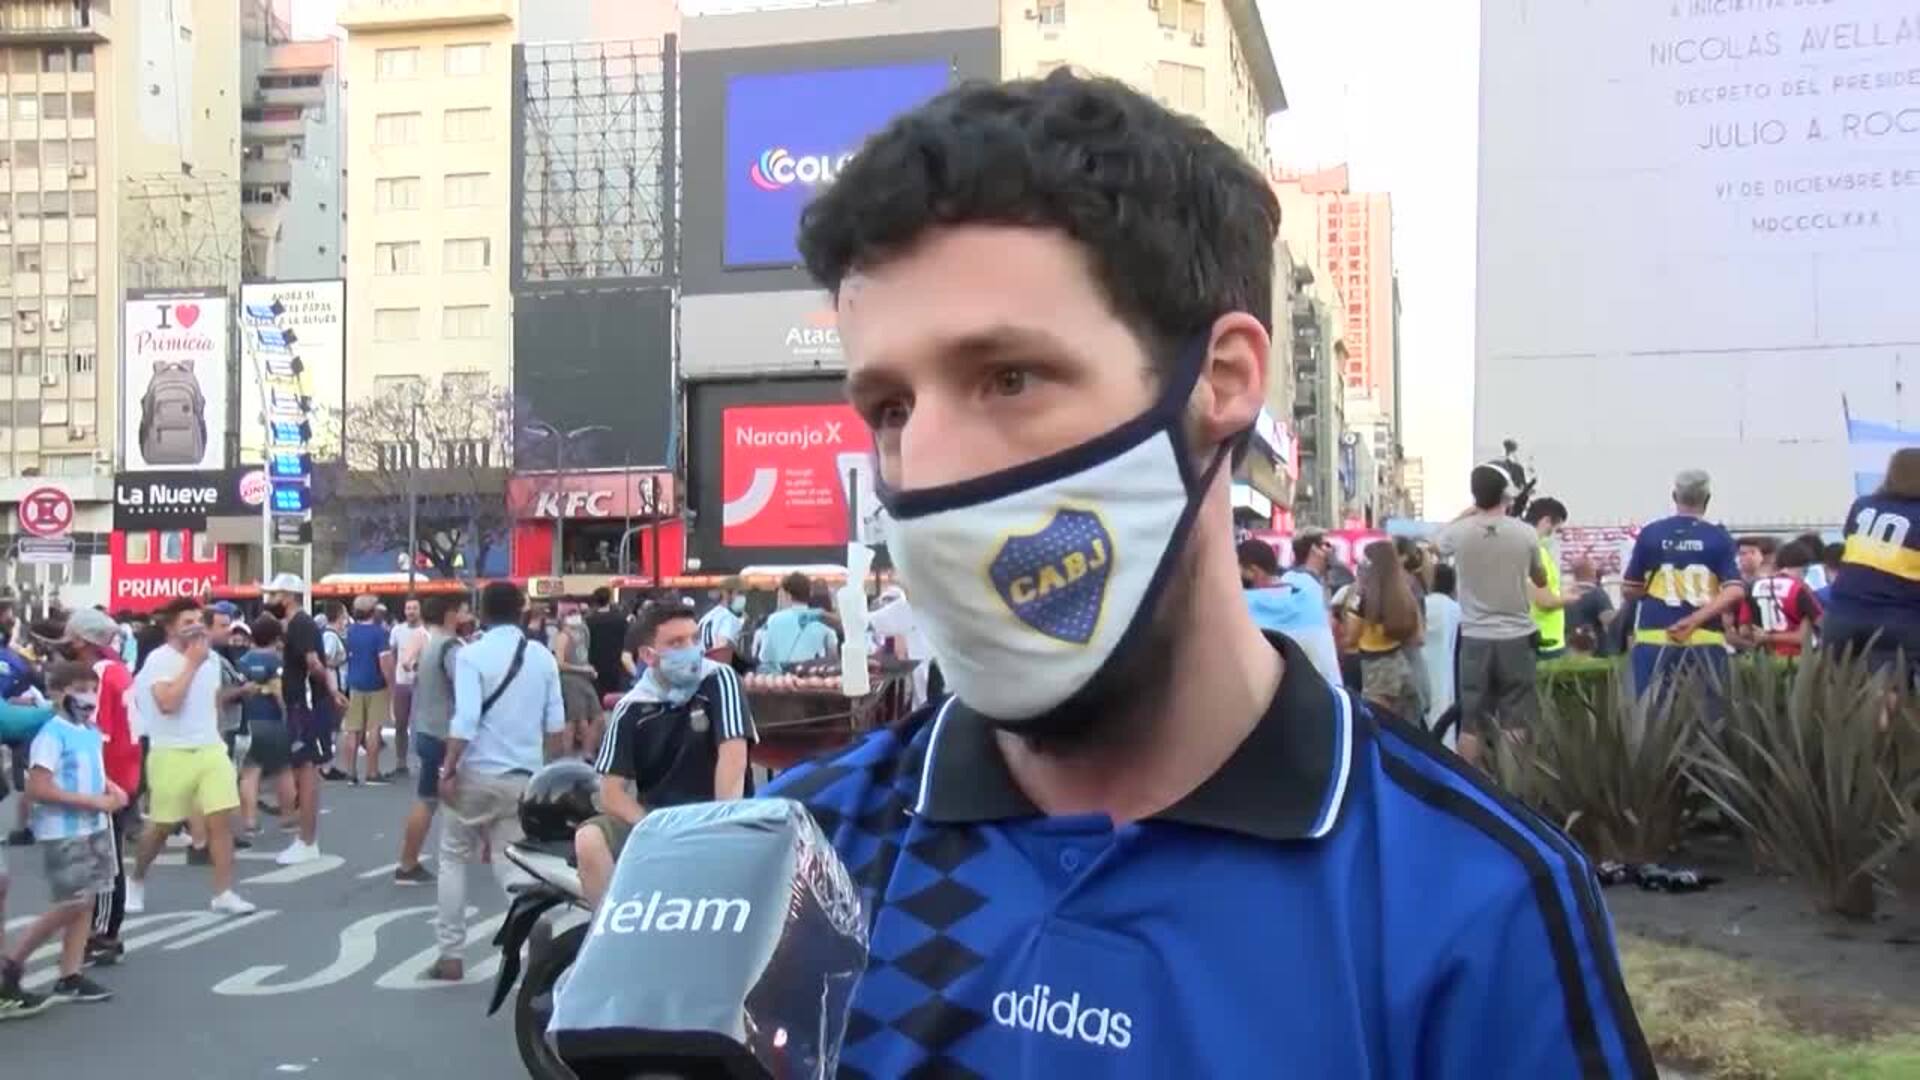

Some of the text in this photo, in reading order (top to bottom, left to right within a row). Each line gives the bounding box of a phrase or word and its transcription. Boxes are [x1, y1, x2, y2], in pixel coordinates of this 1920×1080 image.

[1649, 31, 1781, 66] NICOLAS
[1674, 83, 1771, 106] DECRETO
[1782, 79, 1820, 97] DEL
[1697, 120, 1787, 149] JULIO
[1741, 181, 1765, 197] DE
[1775, 171, 1883, 196] DICIEMBRE
[157, 304, 172, 329] I
[135, 330, 216, 355] Primicia
[117, 484, 218, 505] La Nueve
[534, 490, 613, 517] KFC
[1854, 507, 1911, 552] 10
[1008, 538, 1107, 605] CABJ
[1660, 563, 1716, 607] 10
[117, 576, 213, 598] PRIMICIA
[992, 983, 1133, 1049] adidas
